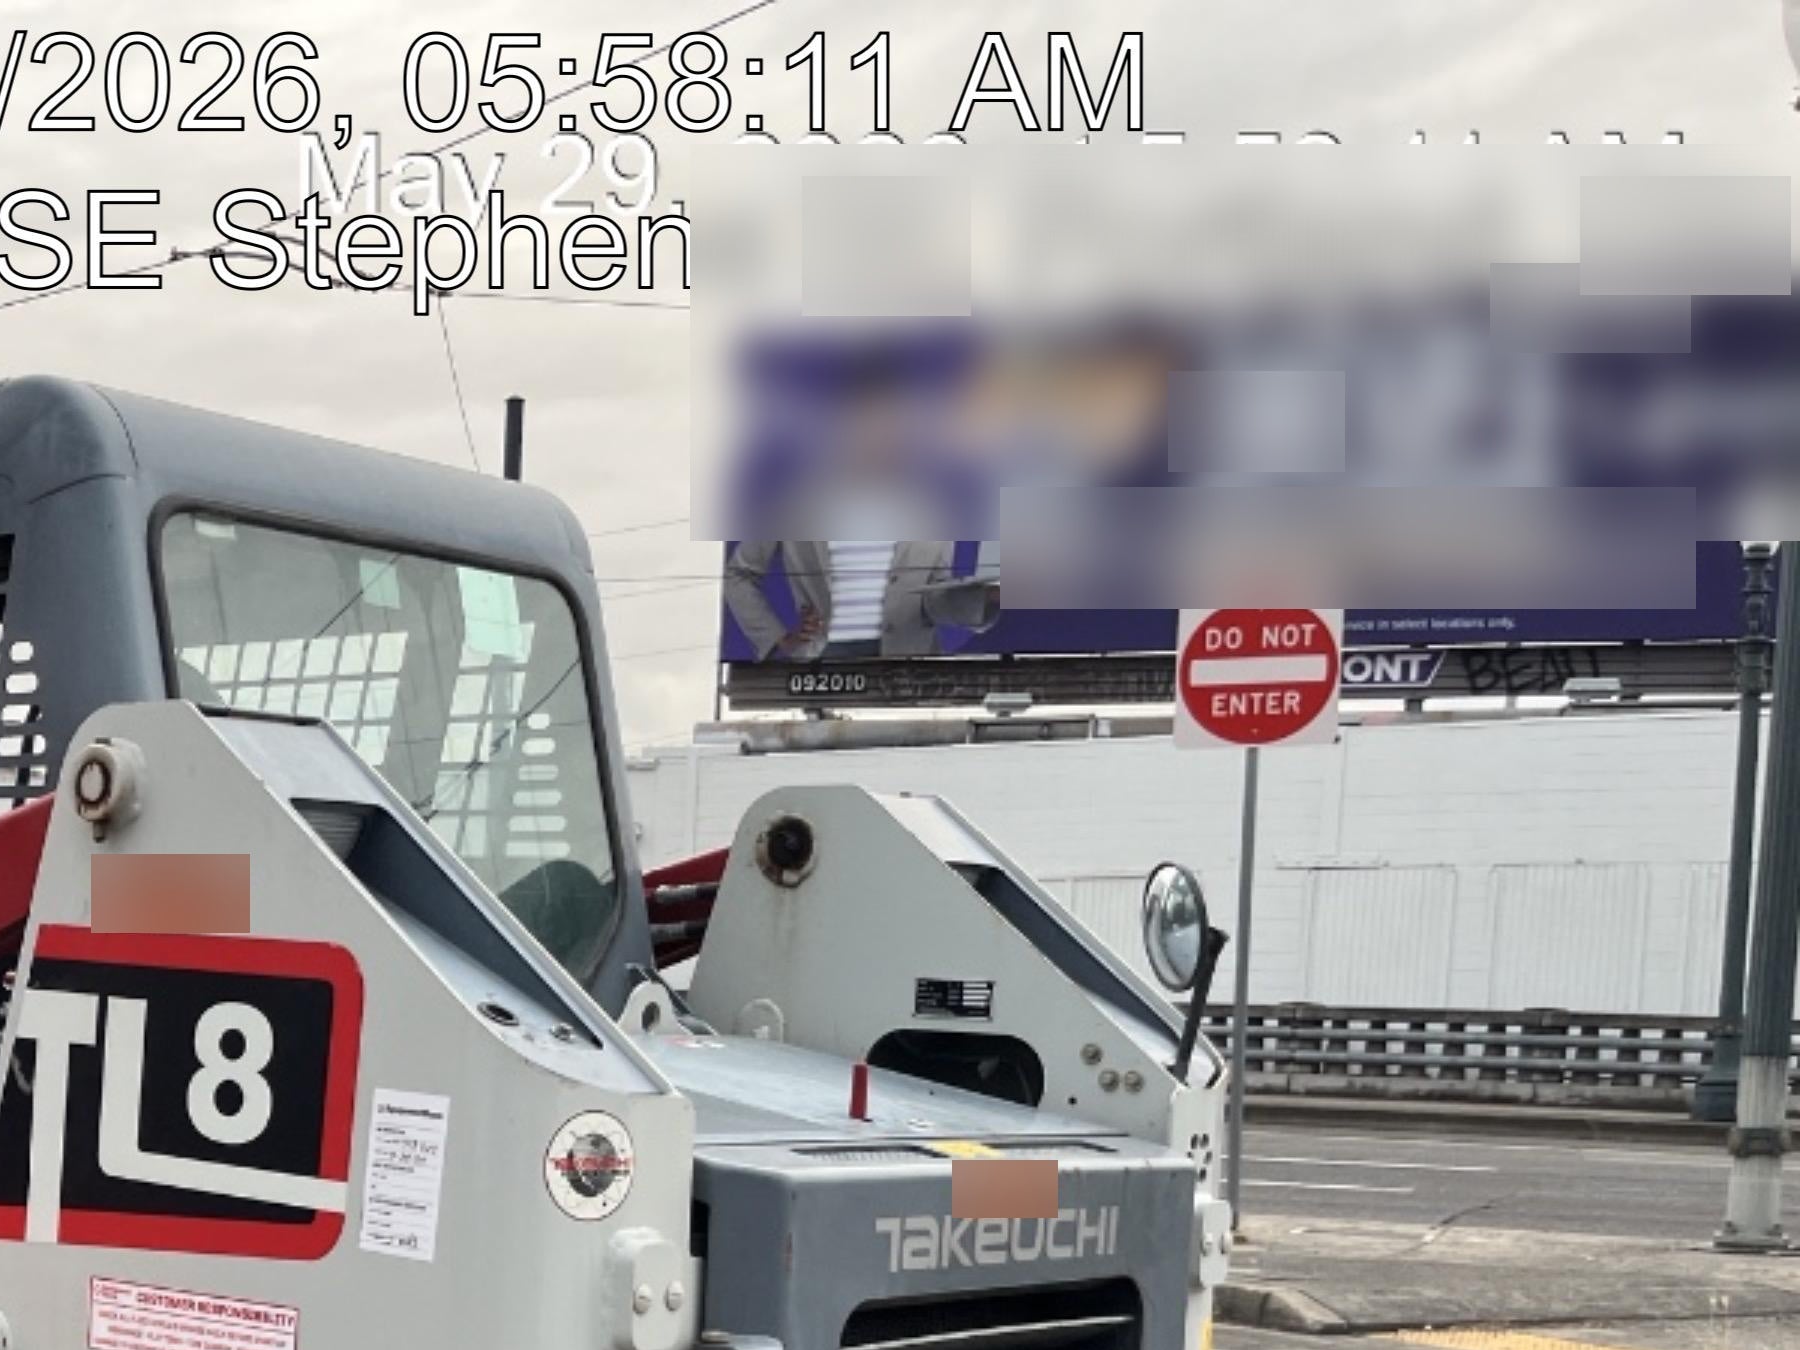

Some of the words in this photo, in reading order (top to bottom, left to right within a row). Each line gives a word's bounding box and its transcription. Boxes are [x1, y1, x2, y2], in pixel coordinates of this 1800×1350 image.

[1205, 626, 1243, 652] DO
[1261, 623, 1318, 649] NOT
[789, 673, 867, 693] 092010
[1211, 690, 1301, 718] ENTER
[15, 988, 348, 1244] TL8
